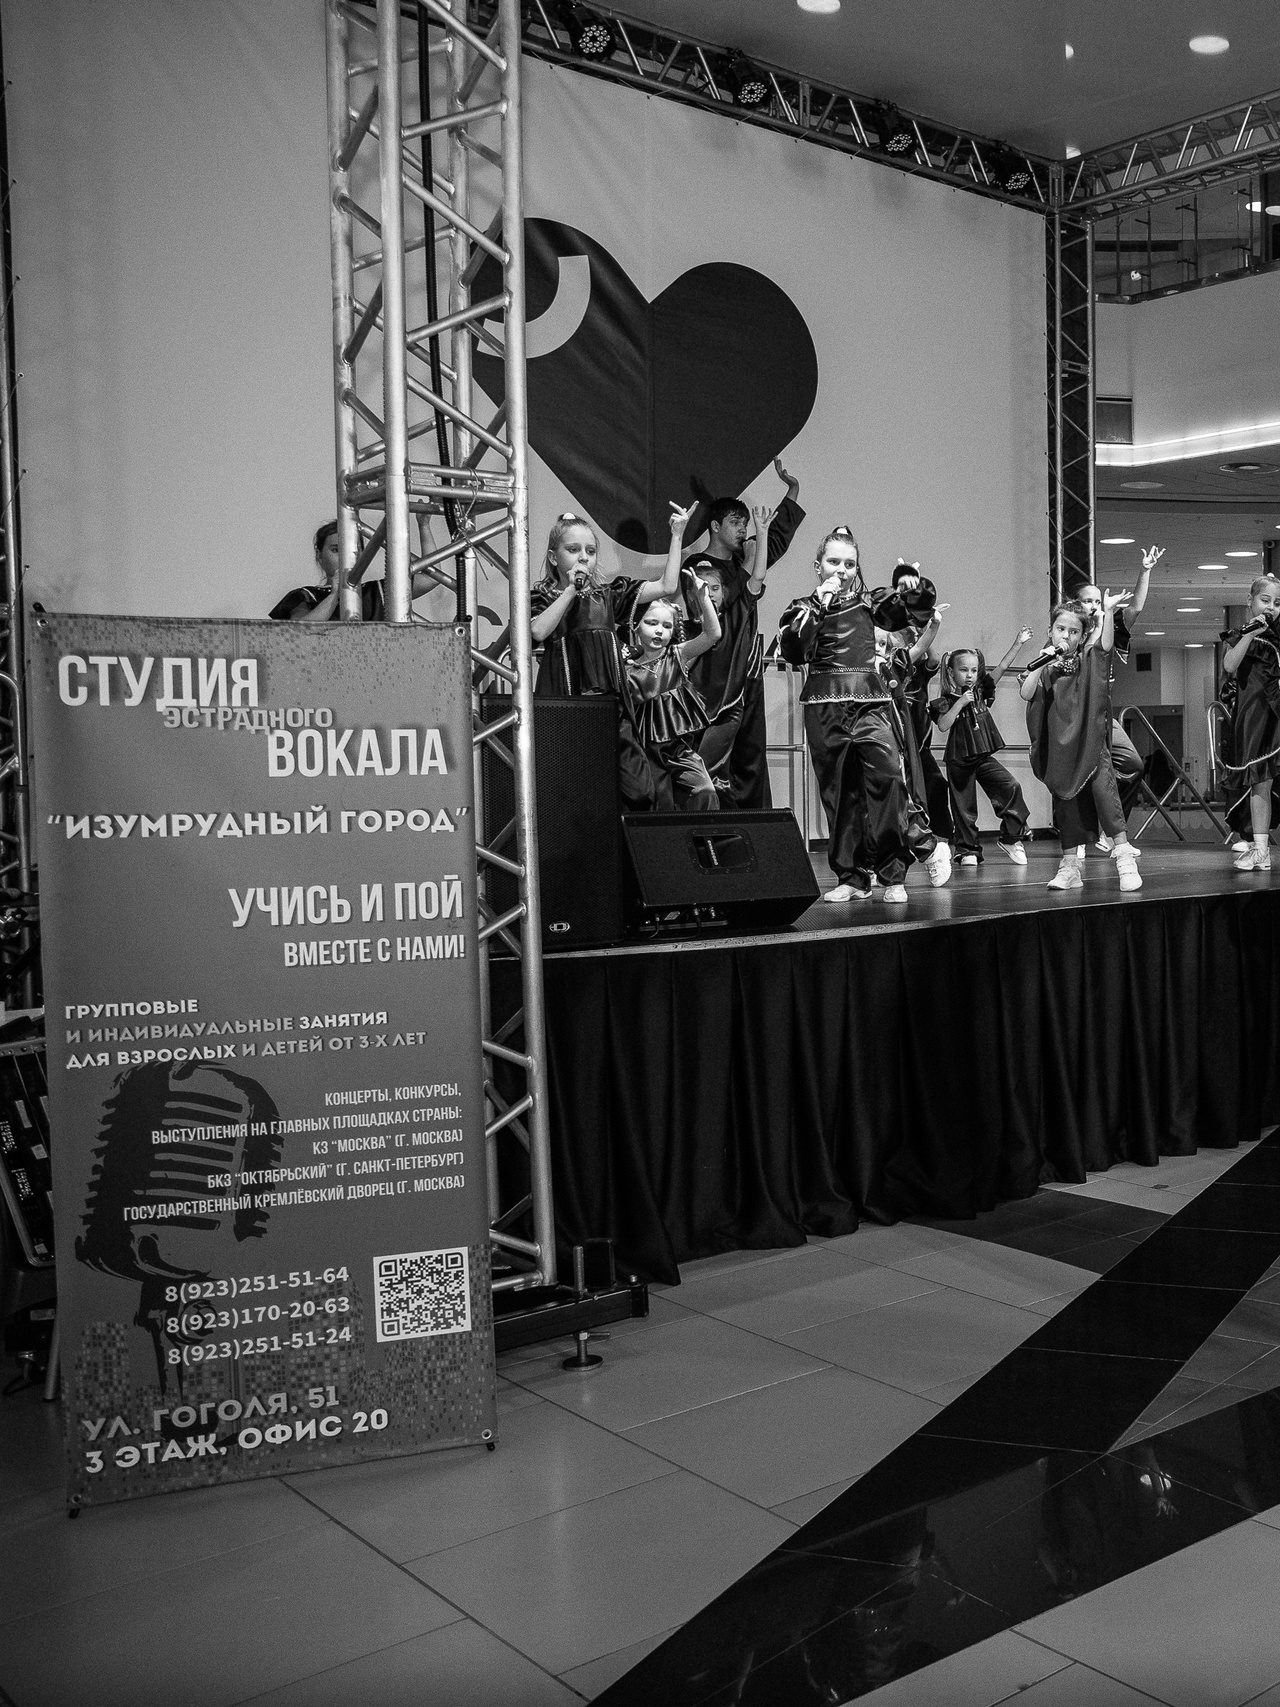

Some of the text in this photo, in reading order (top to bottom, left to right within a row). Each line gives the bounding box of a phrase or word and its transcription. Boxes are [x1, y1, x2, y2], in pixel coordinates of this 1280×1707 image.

[59, 656, 258, 712] СТУДИЯ
[164, 708, 332, 734] ЭСТРАДНОГО
[268, 729, 447, 777] ВОКАЛА
[229, 875, 462, 927] УЧИСЬ И ПОЙ
[284, 935, 464, 966] ВМЕСТЕ С НАМИ!
[66, 999, 197, 1019] ГРУППОВЫЕ
[67, 1012, 387, 1043] И ИНДИВИДУАЛЬНЫЕ ЗАНЯТИЯ
[66, 1032, 425, 1069] ДЛЯ ВЗРОСЛЫХ И ДЕТЕЙ ОТ 3-Х ЛЕТ
[325, 1083, 461, 1106] КОНЦЕРТЫ, КОНКУРСЫ,
[152, 1105, 462, 1144] ВЫСТУПЛЕНИЯ НА ГЛАВНЫХ ПЛОЩАДКАХ СТРАНЫ:
[313, 1141, 328, 1154] КЗ
[412, 1129, 463, 1145] МОСКВА)
[207, 1173, 232, 1188] БКЗ
[354, 1152, 463, 1174] САНКТ-ПЕТЕРБУРГ)
[124, 1194, 251, 1220] ГОСУДАРСТВЕННЫЙ
[255, 1185, 344, 1207] КРЕМЛЁВСКИЙ
[347, 1182, 395, 1201] ДВОРЕЦ
[414, 1175, 464, 1192] МОСКВА)
[166, 1266, 349, 1303] 8(923)251-51-64
[167, 1297, 350, 1334] 8(923)170-20-63
[169, 1326, 352, 1365] 8(923)251-51-24
[83, 1386, 339, 1440] УЛ. ГОГОЛЯ, 51
[86, 1409, 387, 1473] 3 ЭТАЖ, ОФИС 20
